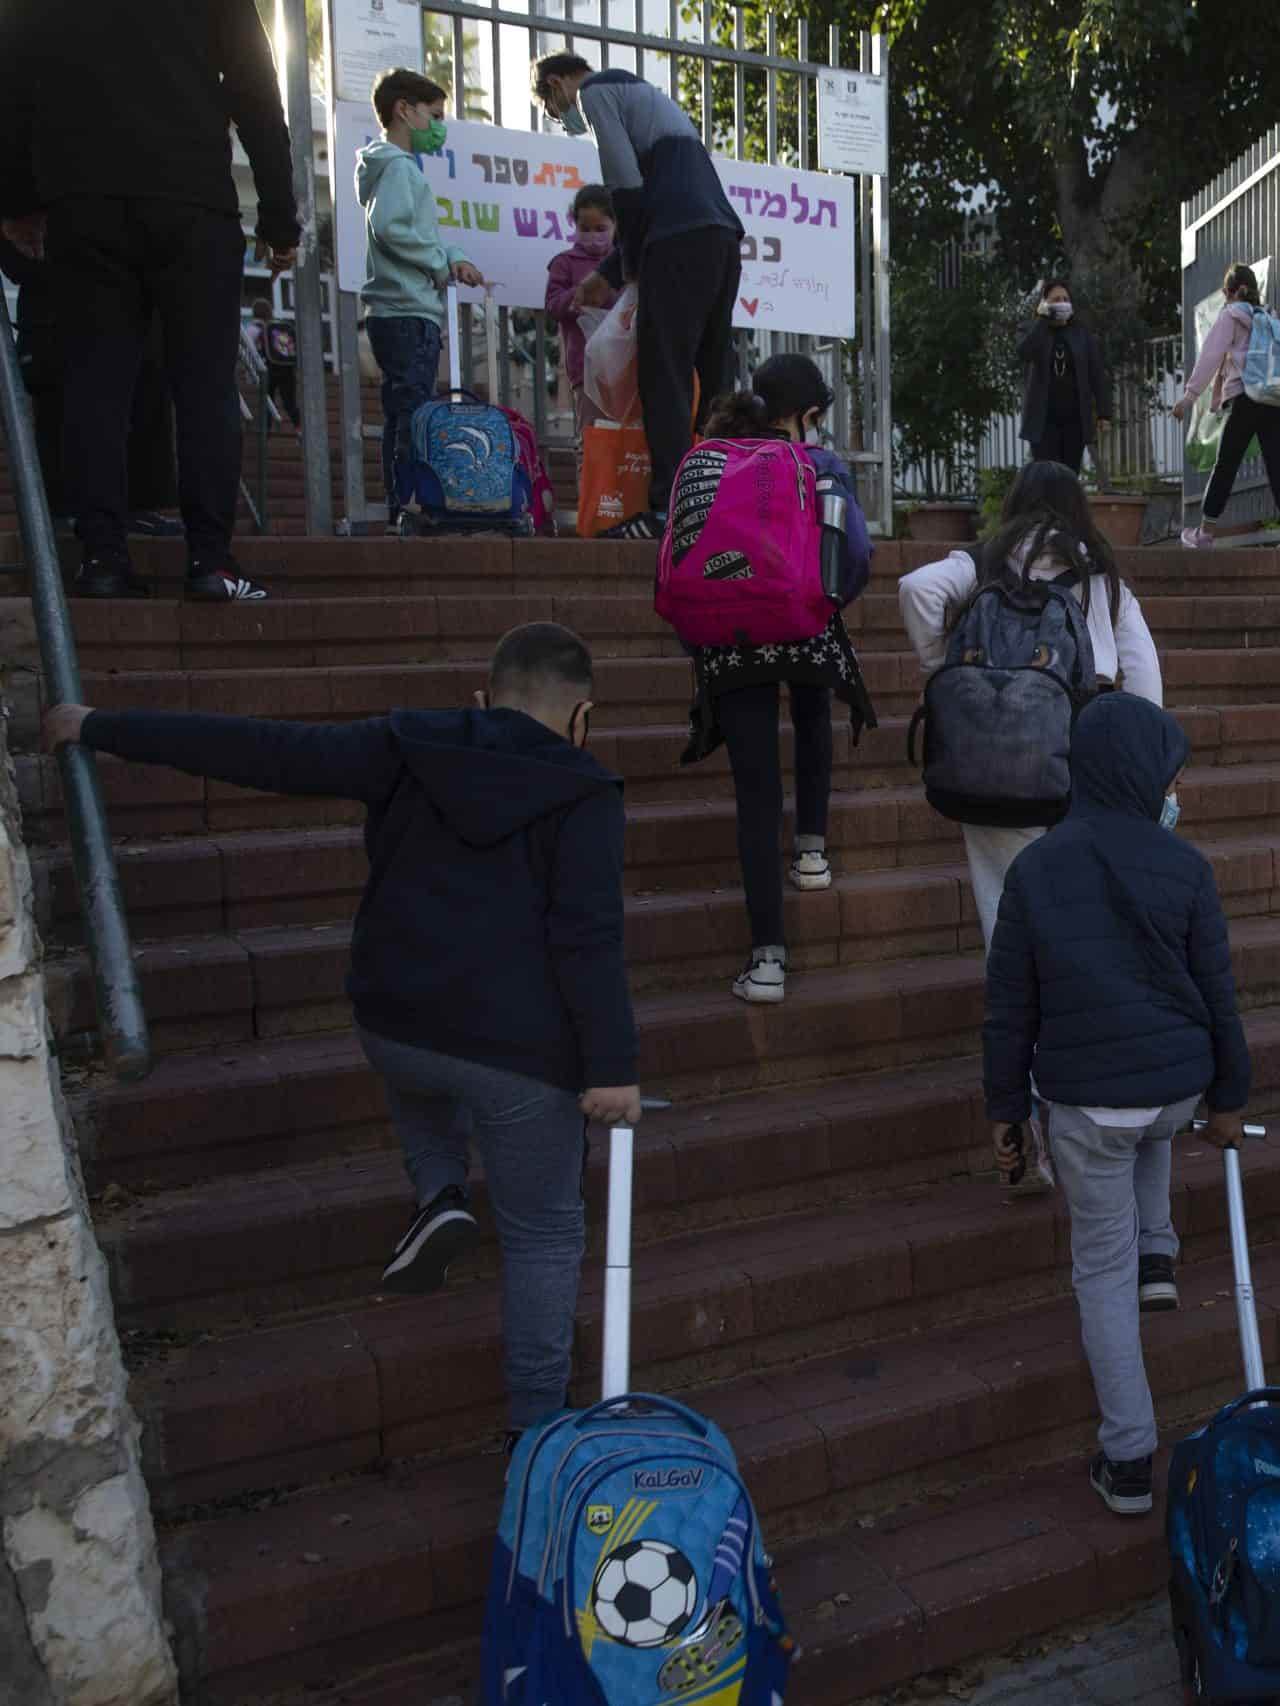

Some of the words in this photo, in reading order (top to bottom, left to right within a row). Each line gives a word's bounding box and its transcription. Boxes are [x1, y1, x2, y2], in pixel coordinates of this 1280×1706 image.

[472, 153, 528, 186] ספר
[437, 197, 499, 232] שוב
[729, 182, 837, 228] תלמידי
[224, 577, 267, 599] FILA
